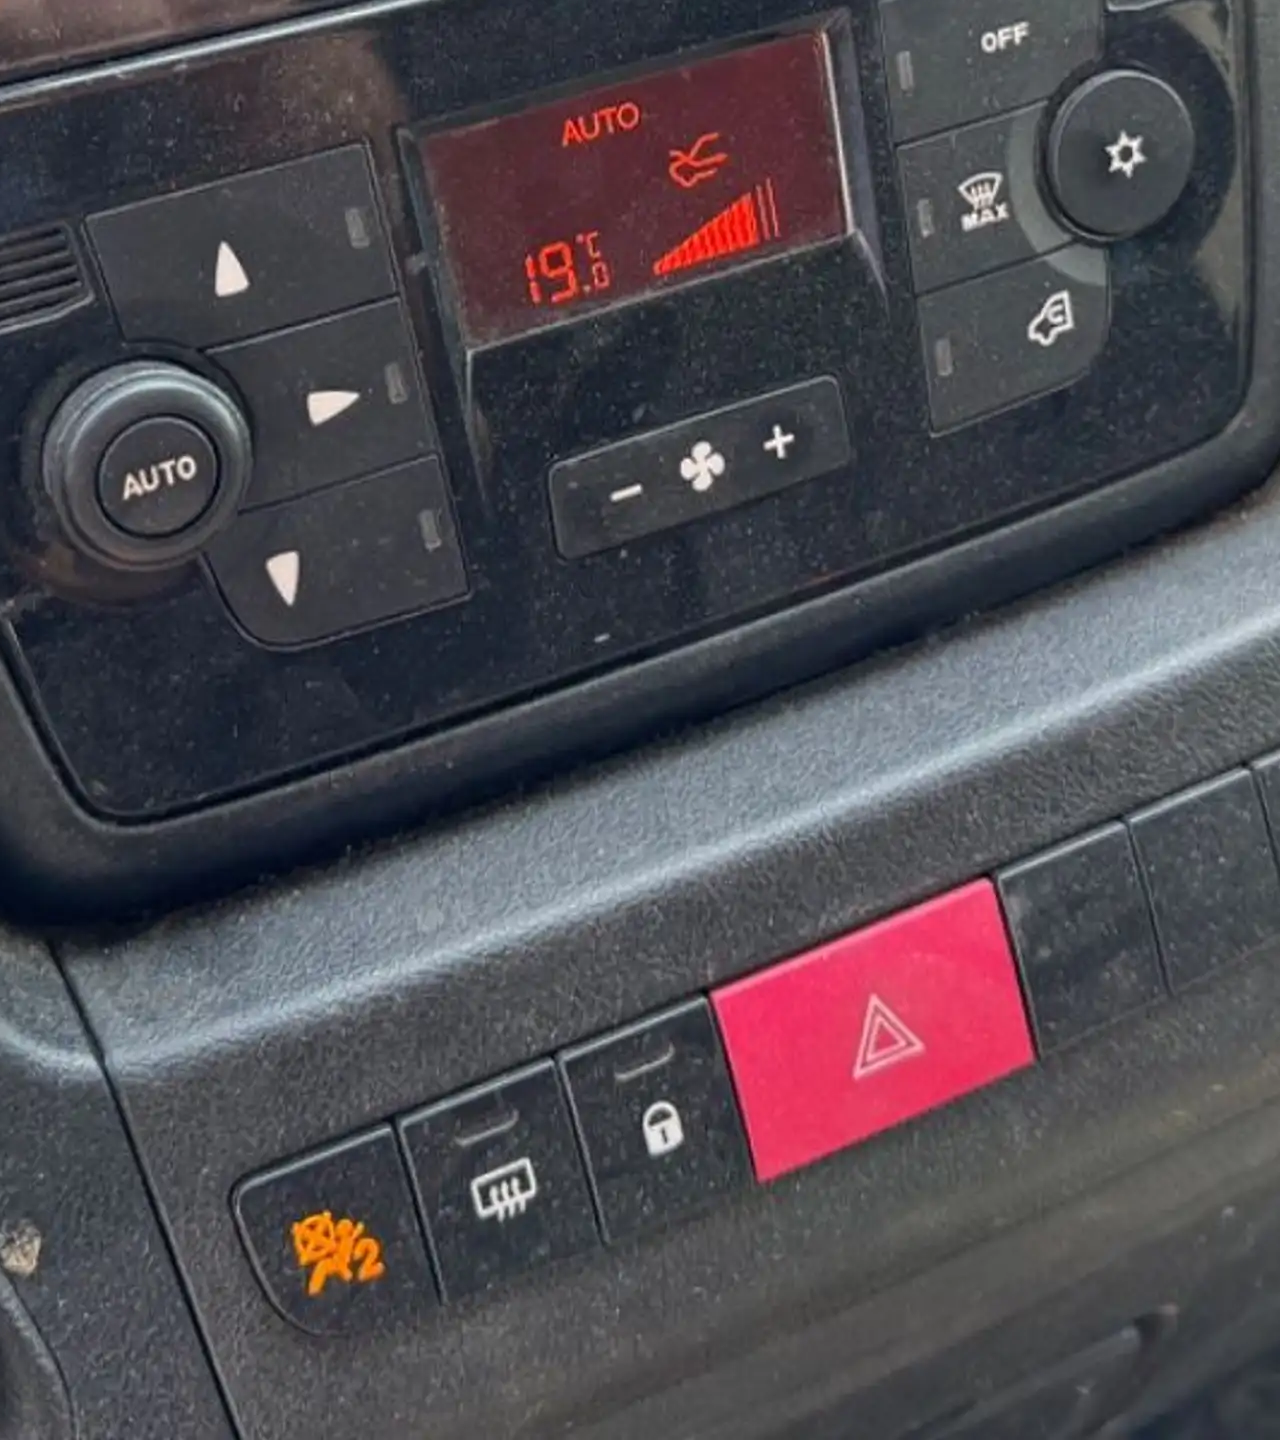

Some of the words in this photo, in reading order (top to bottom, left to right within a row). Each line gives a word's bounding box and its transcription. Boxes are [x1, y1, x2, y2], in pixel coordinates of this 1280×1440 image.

[980, 21, 1031, 54] OFF
[561, 101, 640, 148] AUTO
[960, 202, 1011, 232] MAX
[122, 455, 198, 501] AUTO
